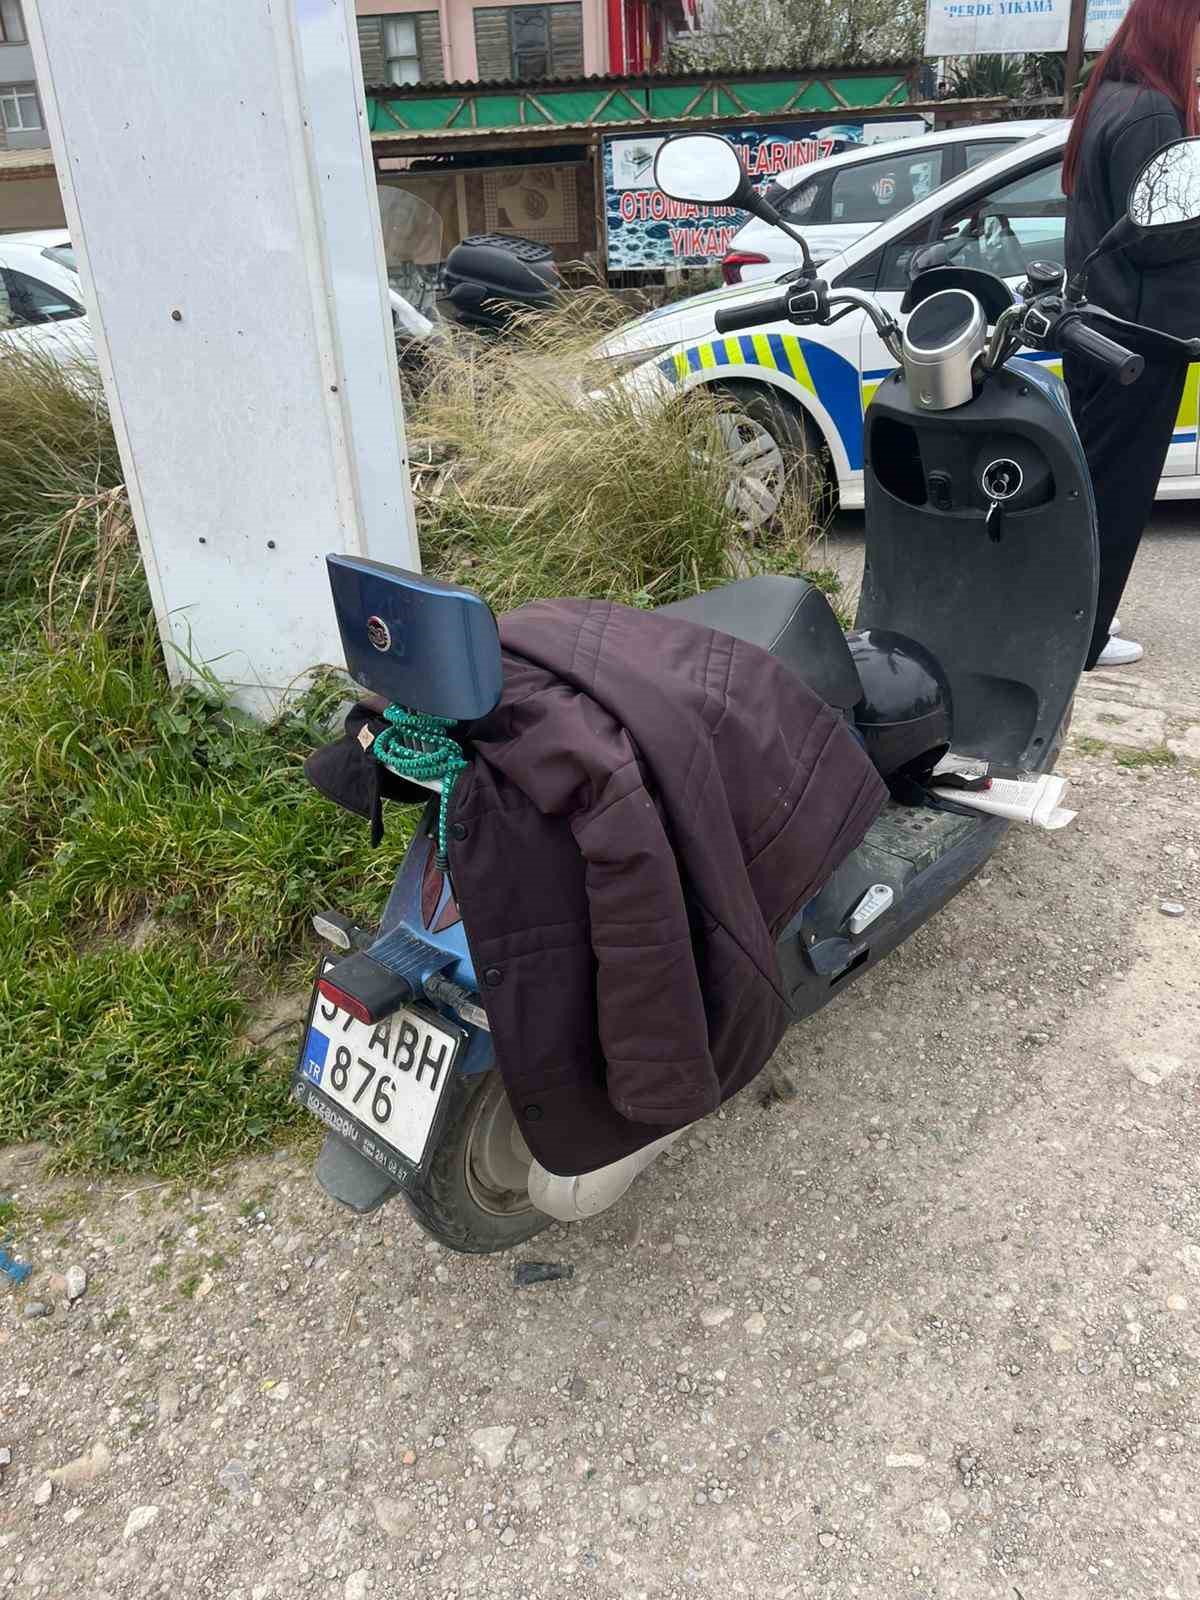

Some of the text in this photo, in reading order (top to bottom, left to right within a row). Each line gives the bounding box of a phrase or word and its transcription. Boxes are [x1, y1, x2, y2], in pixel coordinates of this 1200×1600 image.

[308, 1058, 322, 1081] TR
[330, 1045, 397, 1124] 876
[368, 1018, 448, 1092] ABH
